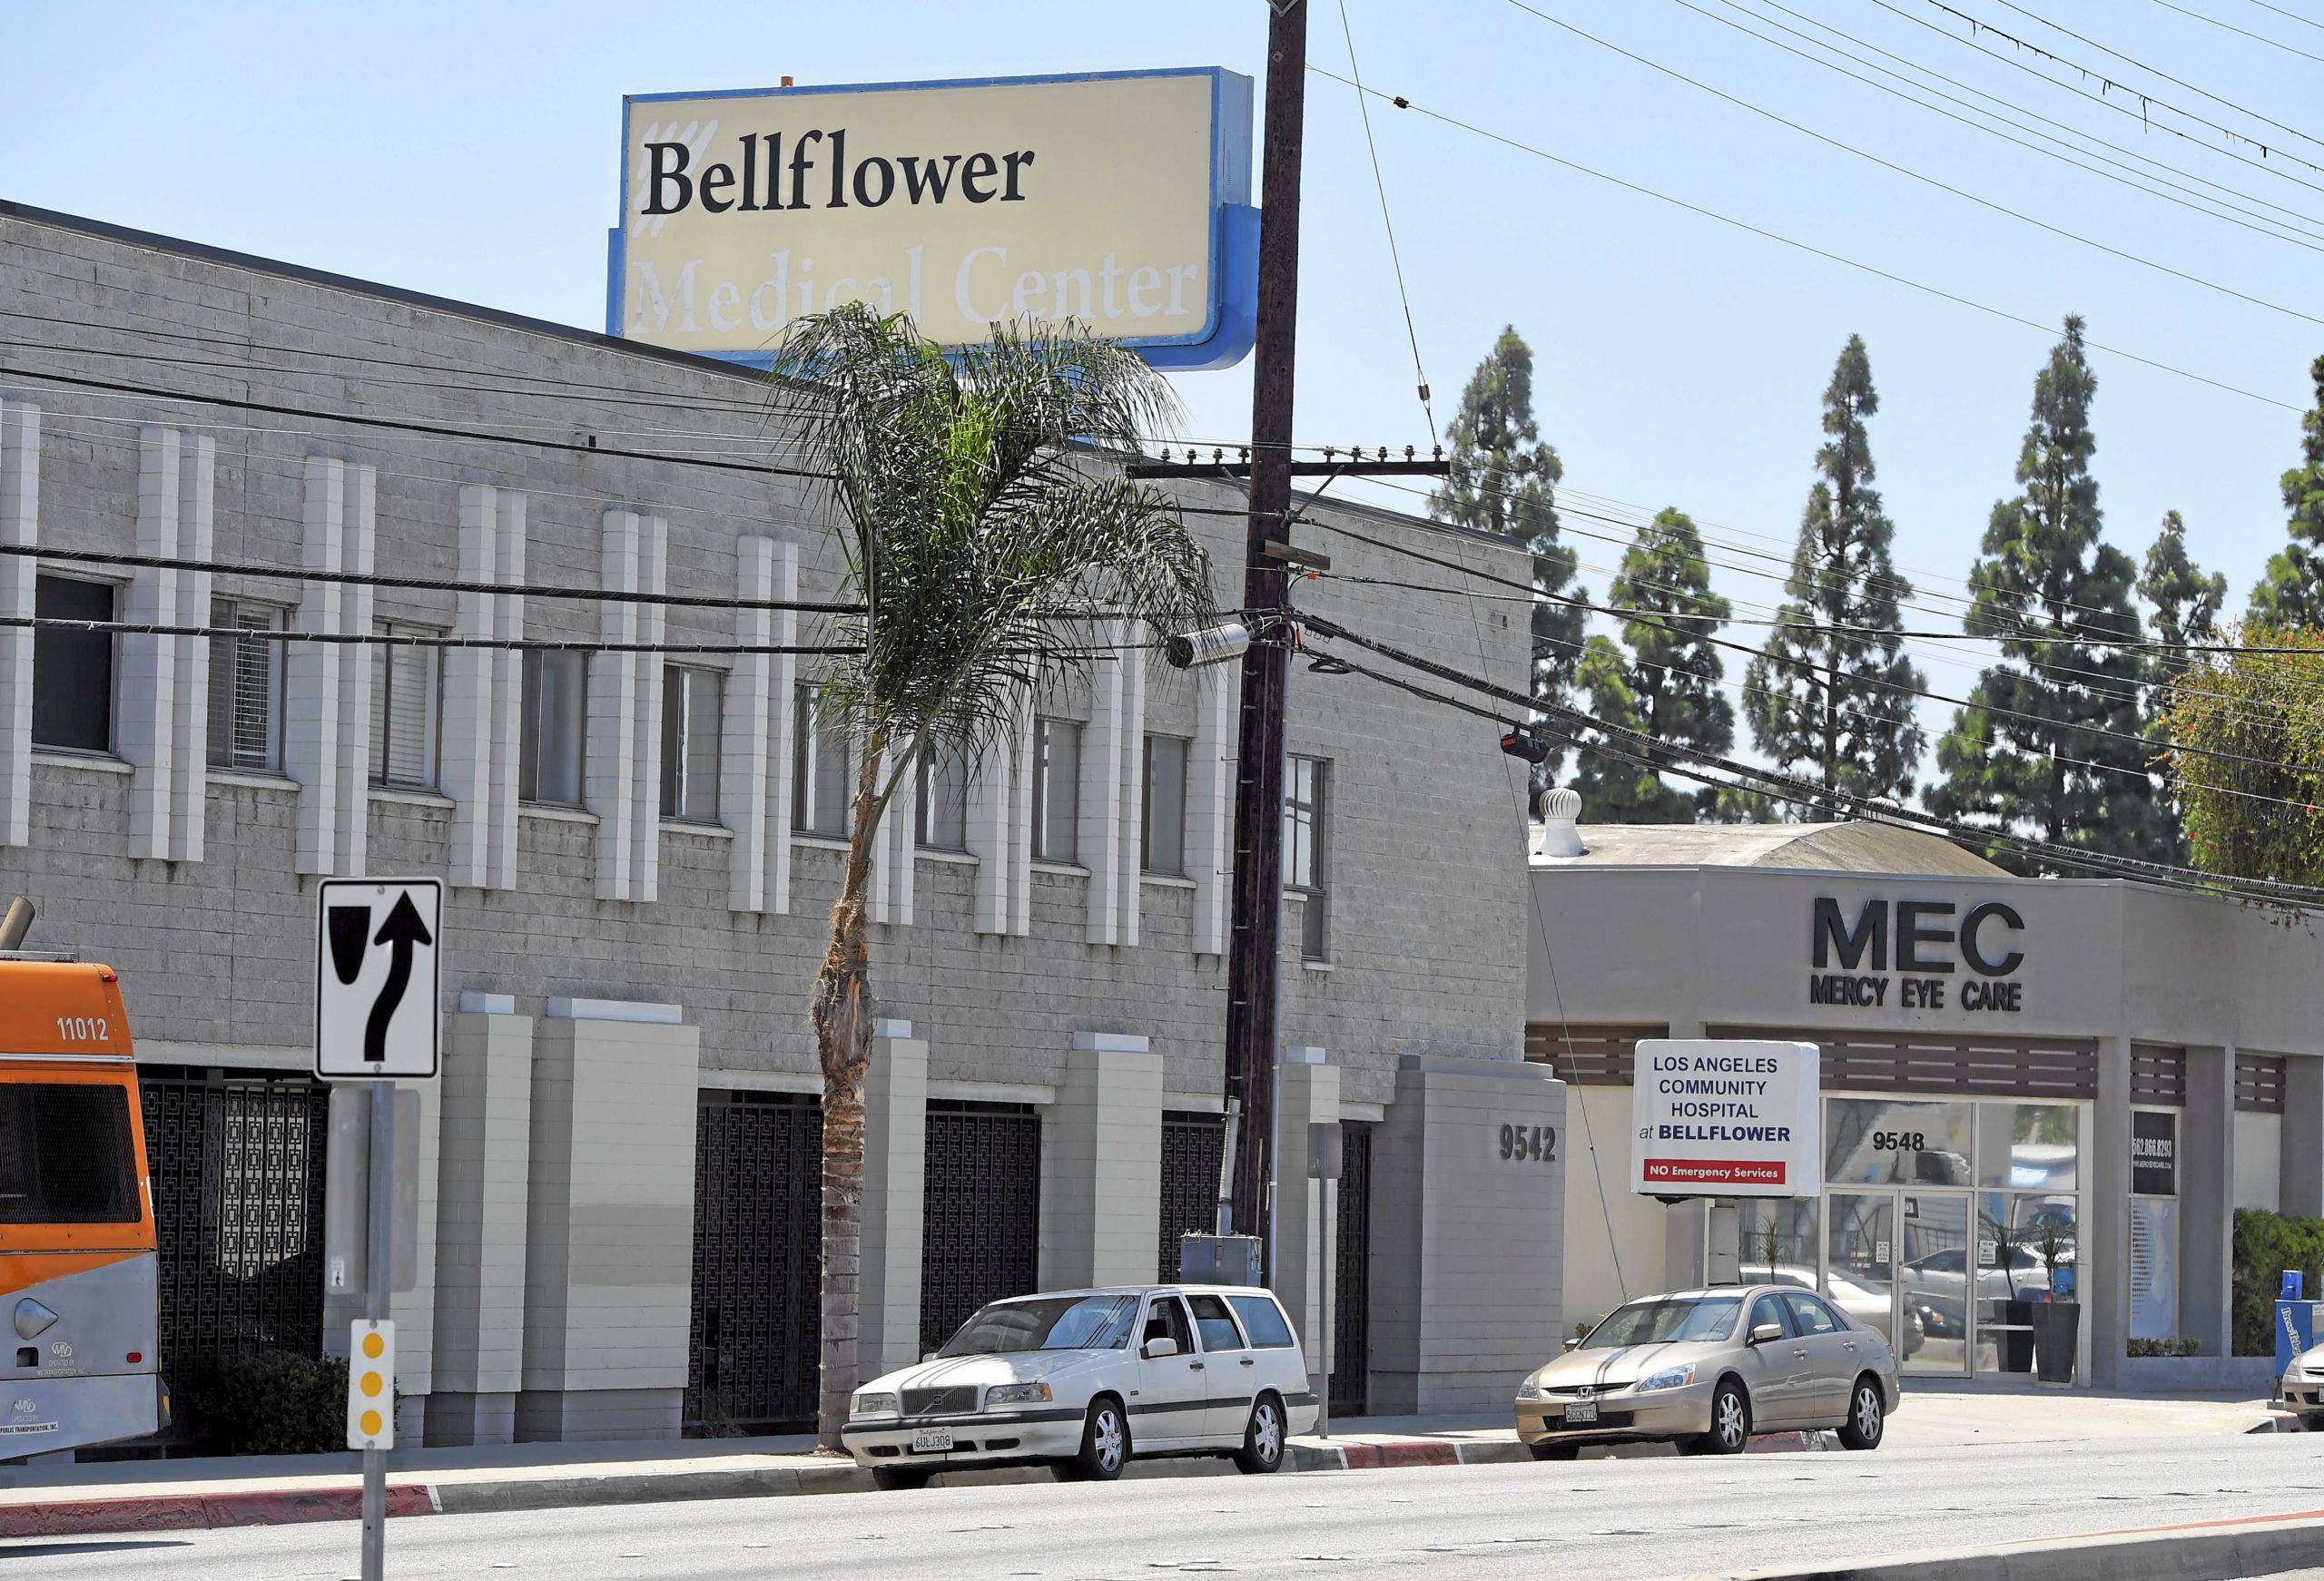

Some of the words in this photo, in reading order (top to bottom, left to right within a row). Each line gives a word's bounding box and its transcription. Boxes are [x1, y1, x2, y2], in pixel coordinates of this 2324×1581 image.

[641, 129, 1035, 215] Bellflower
[633, 246, 927, 334] Medical
[954, 247, 1199, 326] Center
[1812, 898, 2025, 977] MEC
[1810, 975, 1889, 1007] MERCY
[1902, 978, 1944, 1008] EYE
[1961, 981, 2022, 1011] CARE
[57, 1017, 109, 1041] 11012
[1654, 1056, 1689, 1072] LOS
[1694, 1057, 1777, 1073] ANGELES
[1659, 1079, 1767, 1095] COMMUNITY
[1671, 1103, 1758, 1118] HOSPITAL
[1500, 1124, 1555, 1161] 9542
[1639, 1125, 1654, 1139] at
[1659, 1125, 1790, 1142] BELLFLOWER
[1873, 1131, 1925, 1151] 9548
[1649, 1165, 1669, 1175] NO
[1672, 1165, 1730, 1179] Emergency
[1734, 1166, 1778, 1178] Services
[916, 1435, 950, 1448] 6ULJ308
